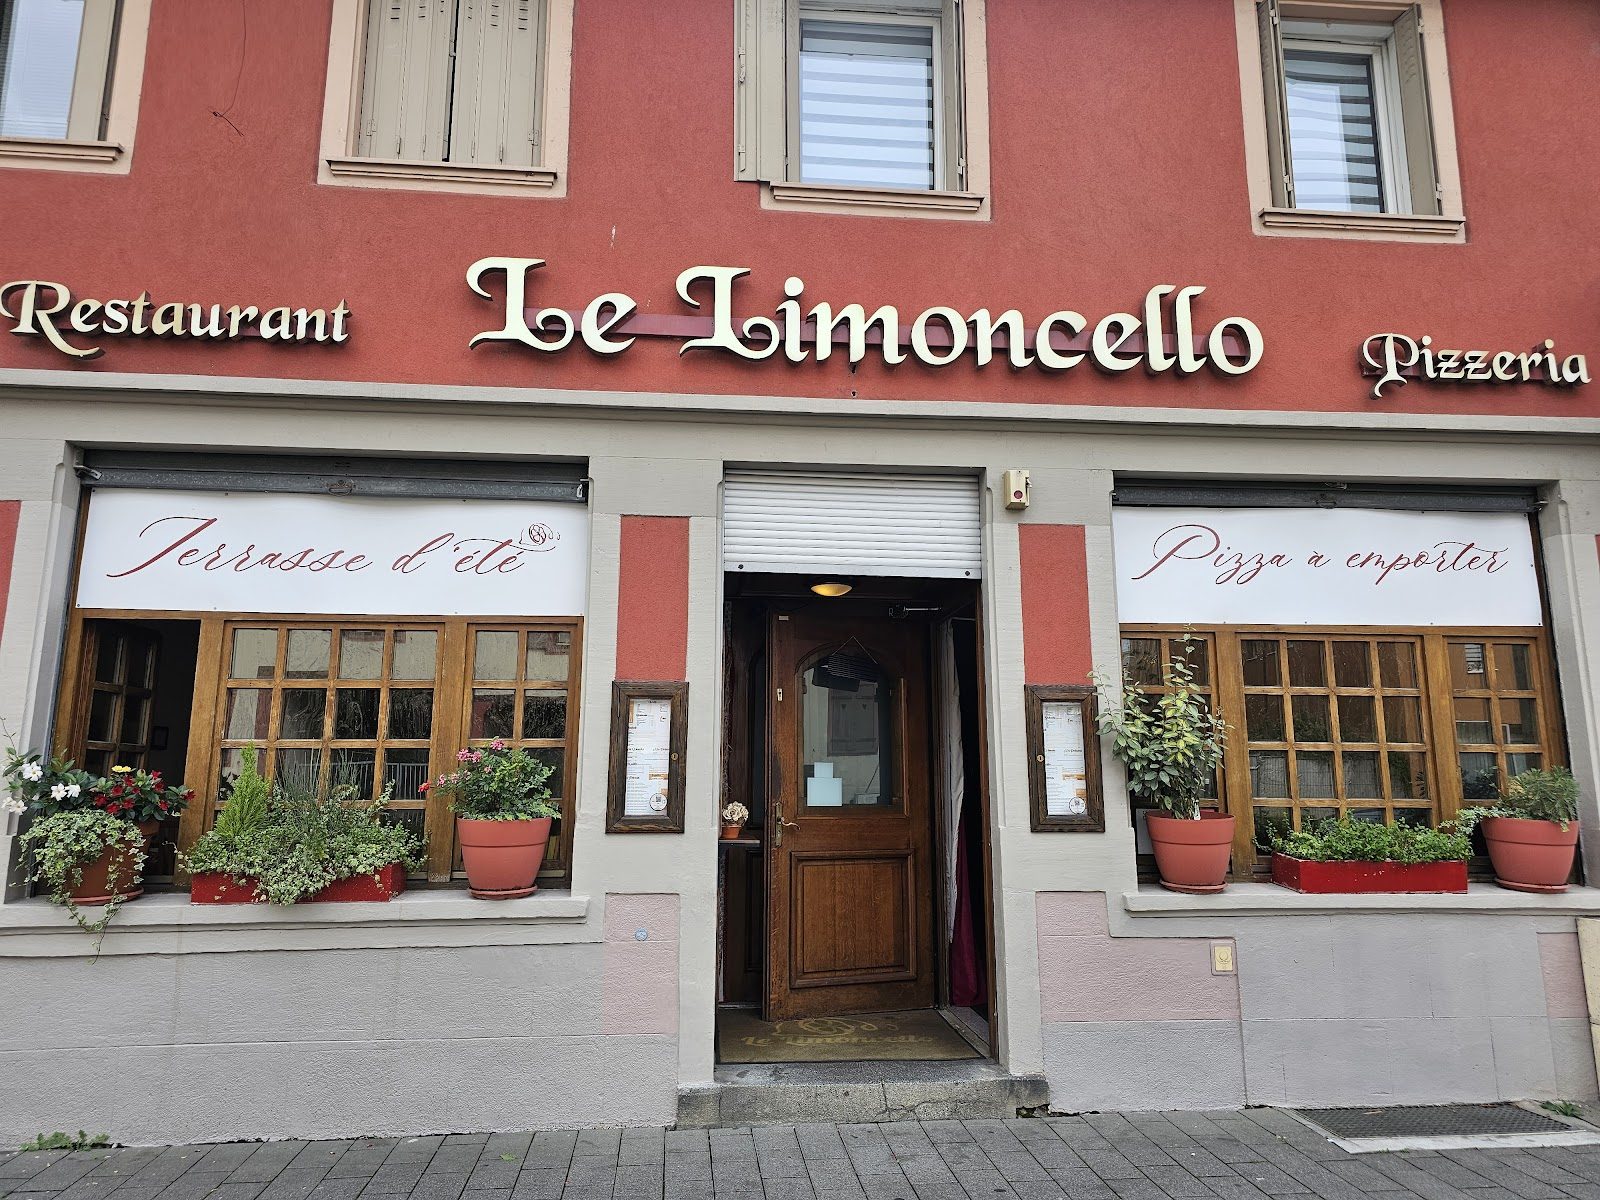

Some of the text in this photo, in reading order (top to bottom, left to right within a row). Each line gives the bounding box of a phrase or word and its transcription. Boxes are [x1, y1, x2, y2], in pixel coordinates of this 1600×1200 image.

[0, 279, 349, 358] Restaurant
[466, 256, 1264, 374] Le Limoncello
[1362, 332, 1592, 398] Pizzeria
[106, 516, 374, 578] Terrasse
[1131, 524, 1509, 586] Pizza à emporter
